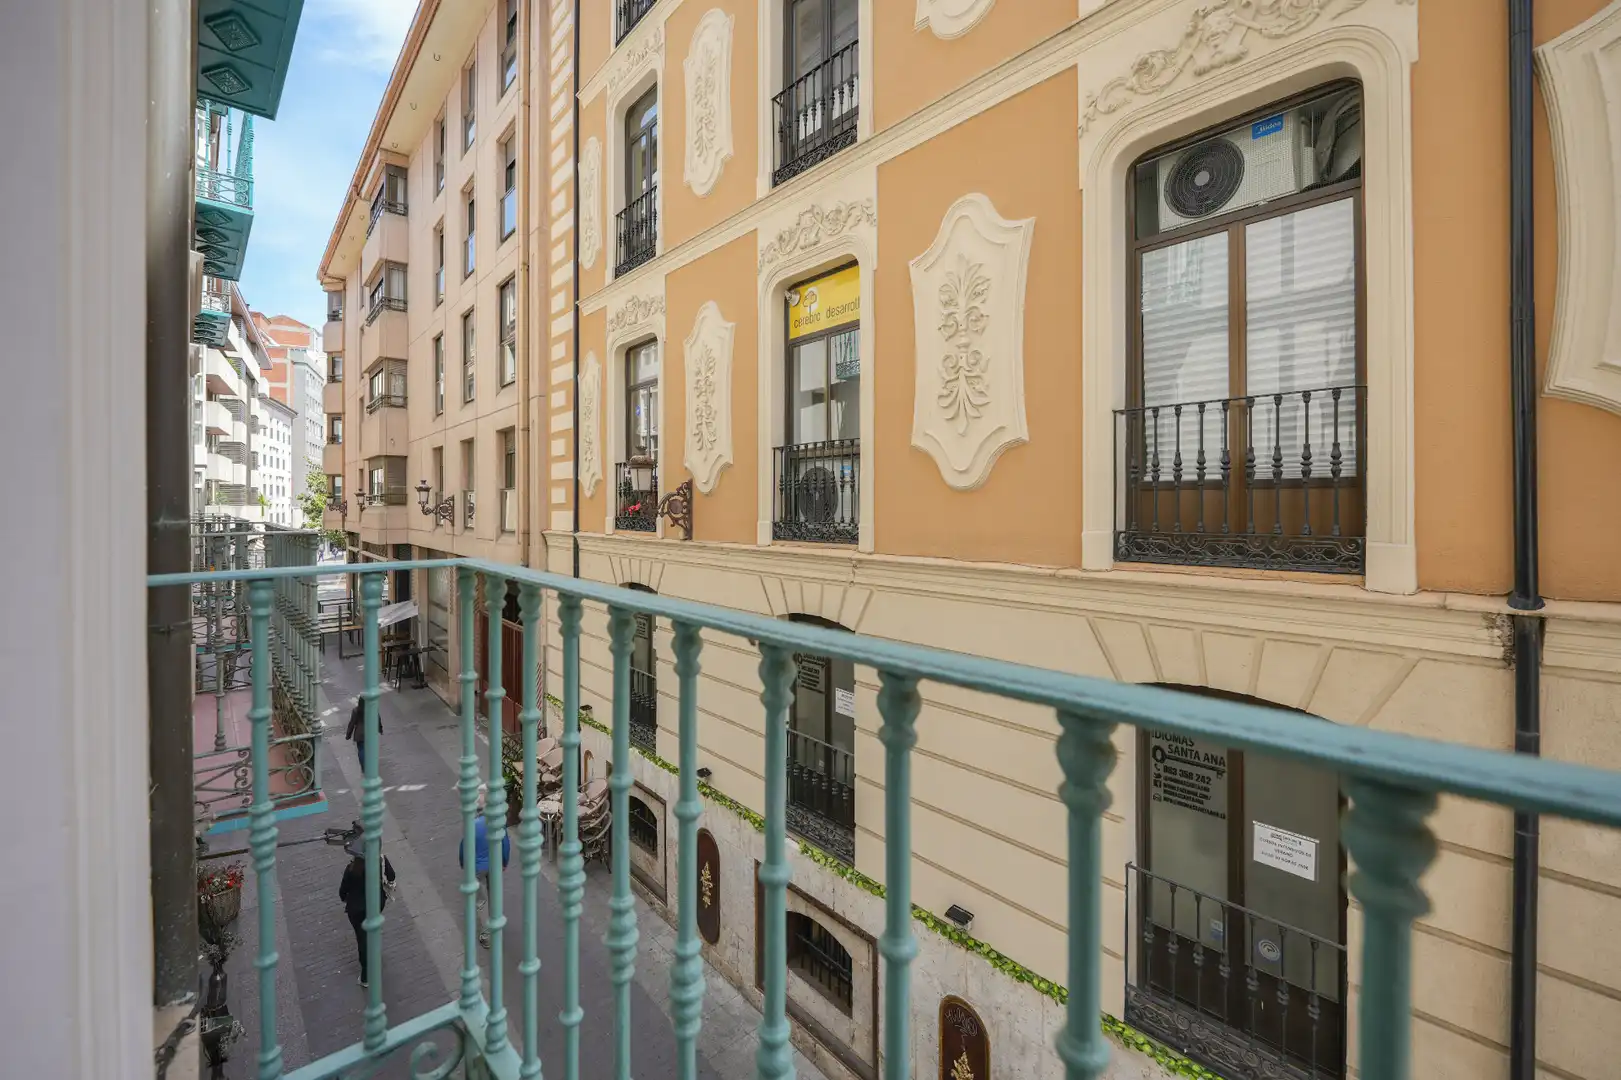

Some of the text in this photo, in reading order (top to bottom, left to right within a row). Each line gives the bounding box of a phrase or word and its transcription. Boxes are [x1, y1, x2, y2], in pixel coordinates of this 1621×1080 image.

[793, 312, 821, 329] cerebro
[1168, 744, 1226, 768] SANTA ANA
[1179, 769, 1194, 781] 358
[1195, 774, 1212, 786] 242
